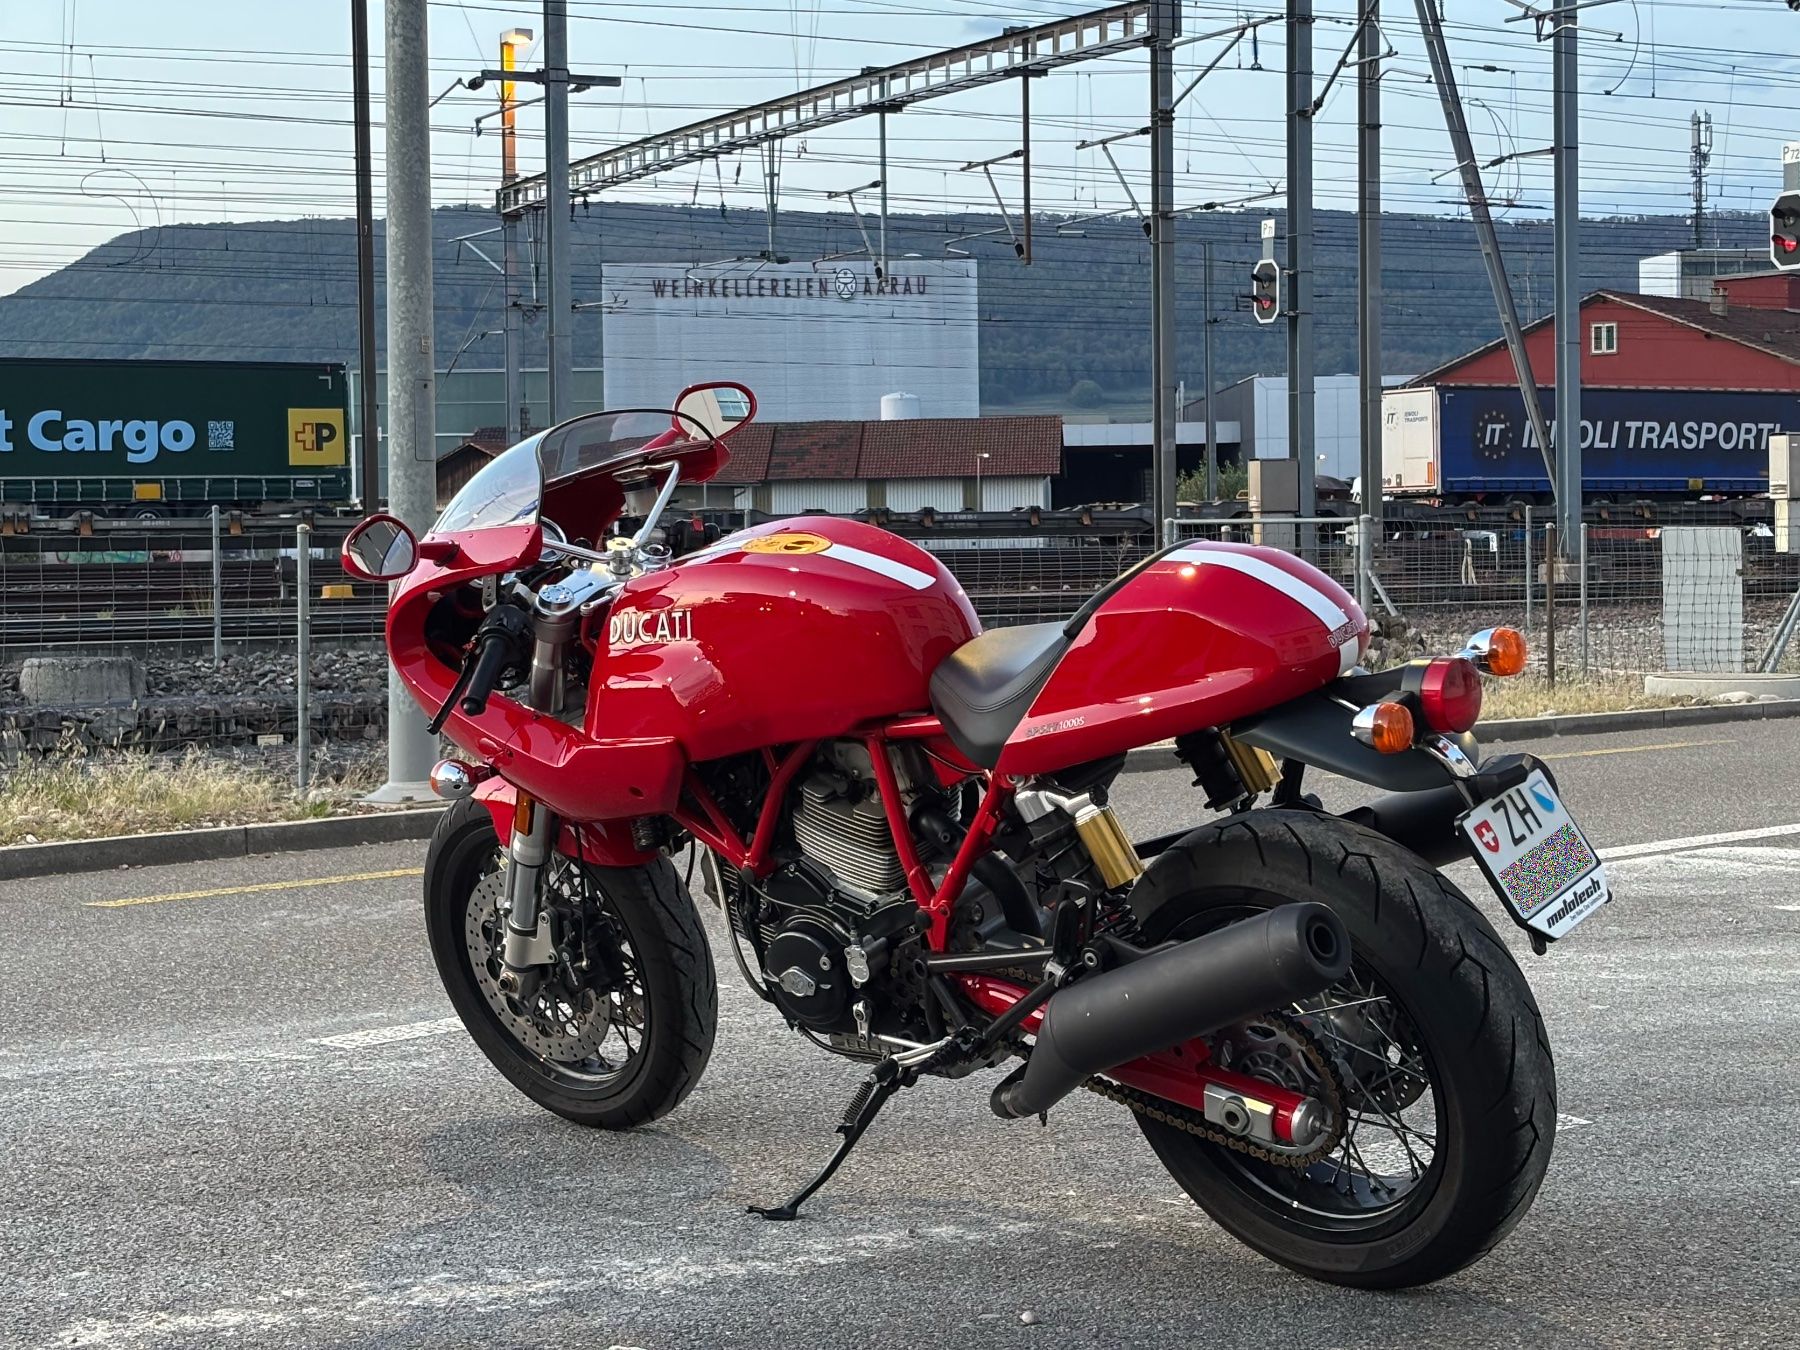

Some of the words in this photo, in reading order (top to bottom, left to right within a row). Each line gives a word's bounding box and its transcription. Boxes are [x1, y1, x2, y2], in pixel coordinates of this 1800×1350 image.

[653, 277, 828, 298] WEINKELLEREIEN
[863, 275, 926, 296] AARAU
[1387, 412, 1396, 425] IT
[1485, 423, 1505, 446] IT
[27, 409, 195, 463] Cargo
[609, 608, 693, 644] DUCATI
[1327, 620, 1360, 648] DUCATI
[1491, 788, 1542, 846] ZH
[1546, 876, 1601, 928] mototech
